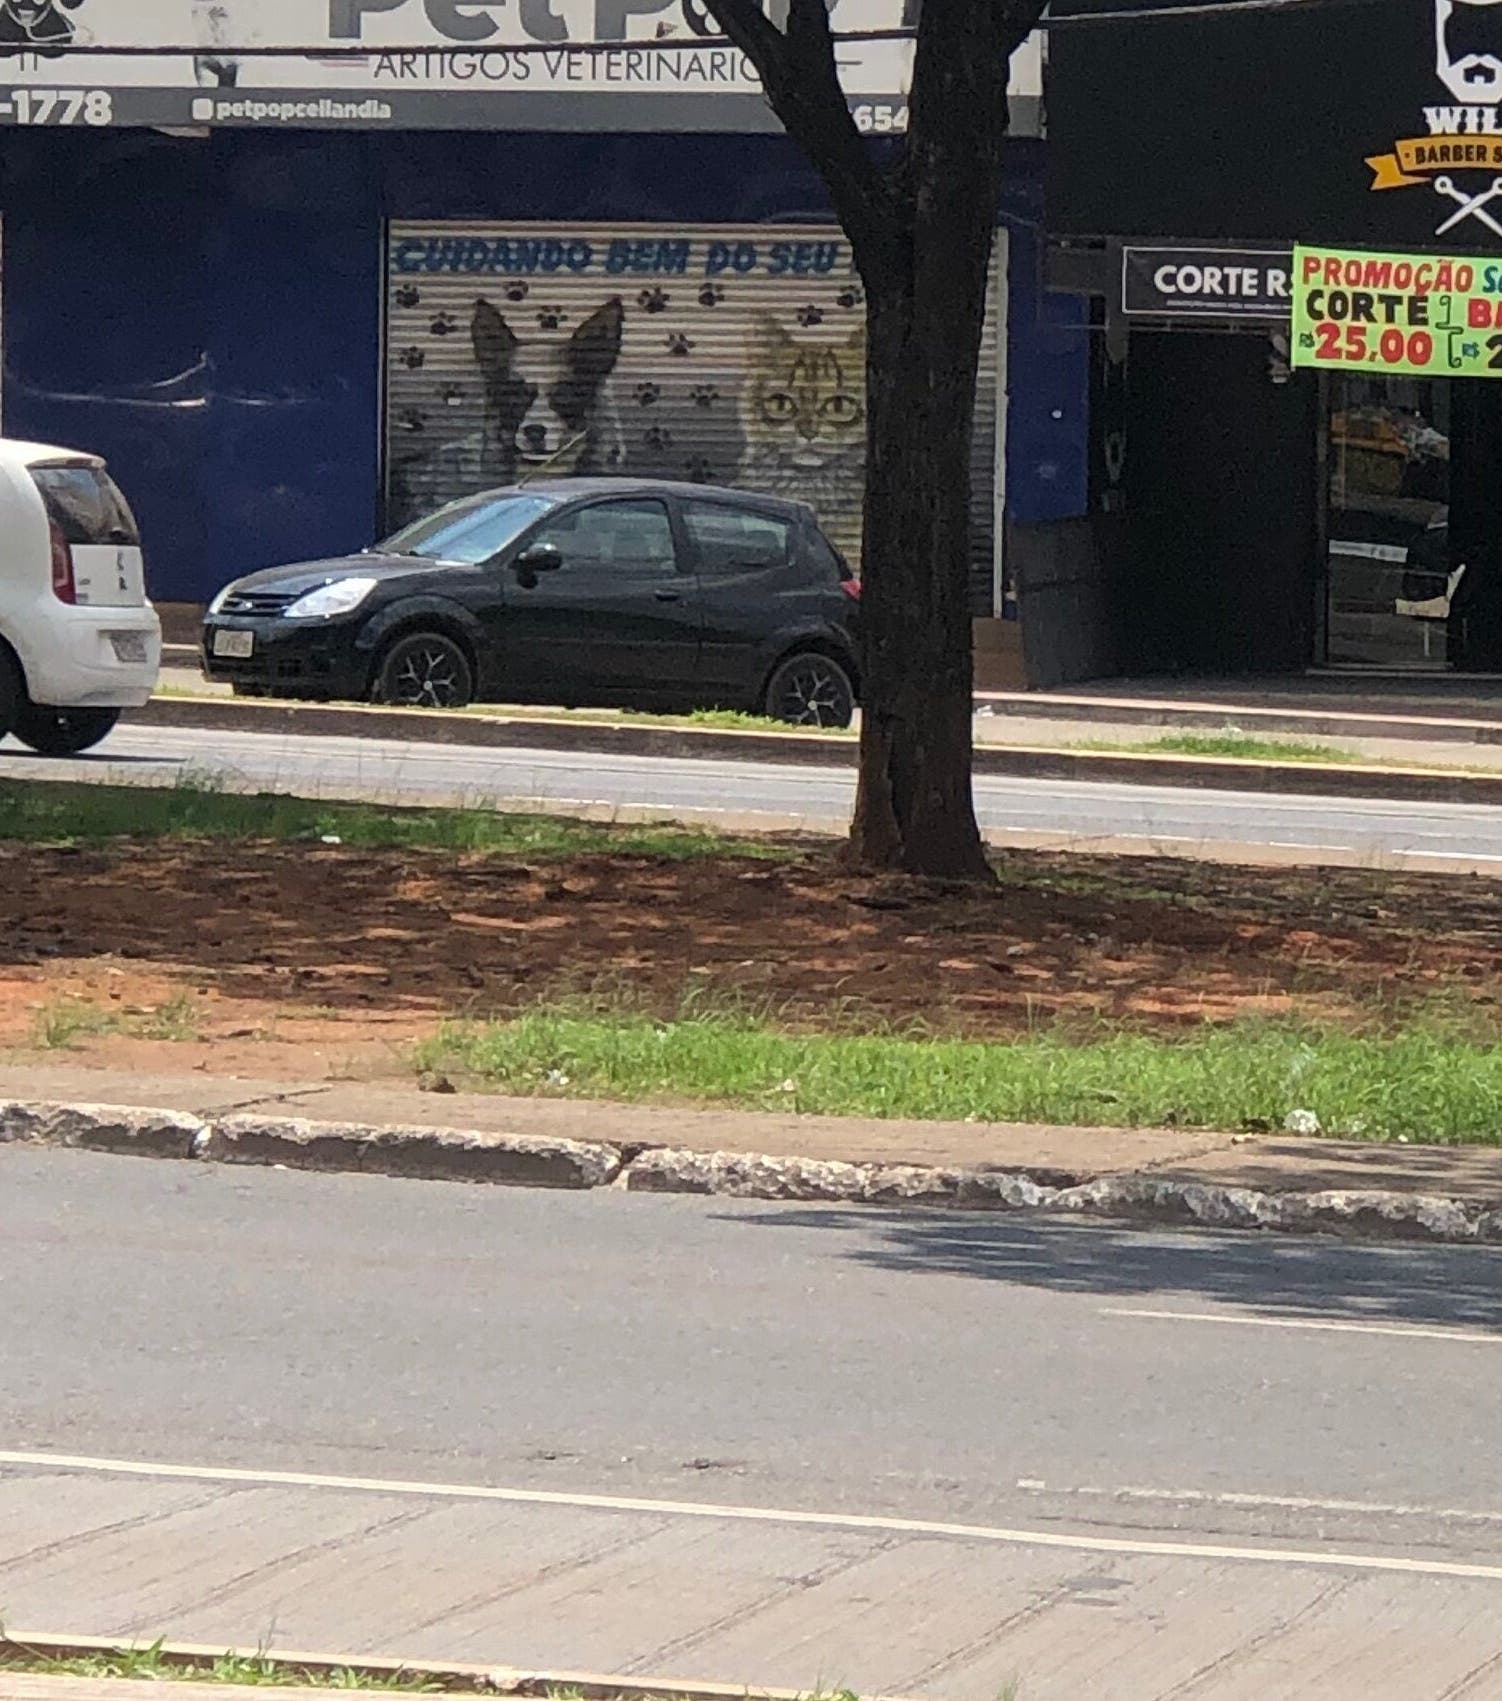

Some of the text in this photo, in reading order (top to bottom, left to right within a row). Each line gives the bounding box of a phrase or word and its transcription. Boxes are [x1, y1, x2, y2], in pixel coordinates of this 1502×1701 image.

[374, 52, 530, 80] ARTIGOS
[1415, 145, 1487, 165] BARBER
[606, 239, 690, 274] BEM
[706, 242, 757, 275] DO
[768, 241, 839, 273] SEU
[1154, 265, 1258, 296] CORTE
[1302, 256, 1474, 296] PROMOÇÃO
[1306, 289, 1429, 326] CORTE
[1315, 322, 1433, 366] 25,00
